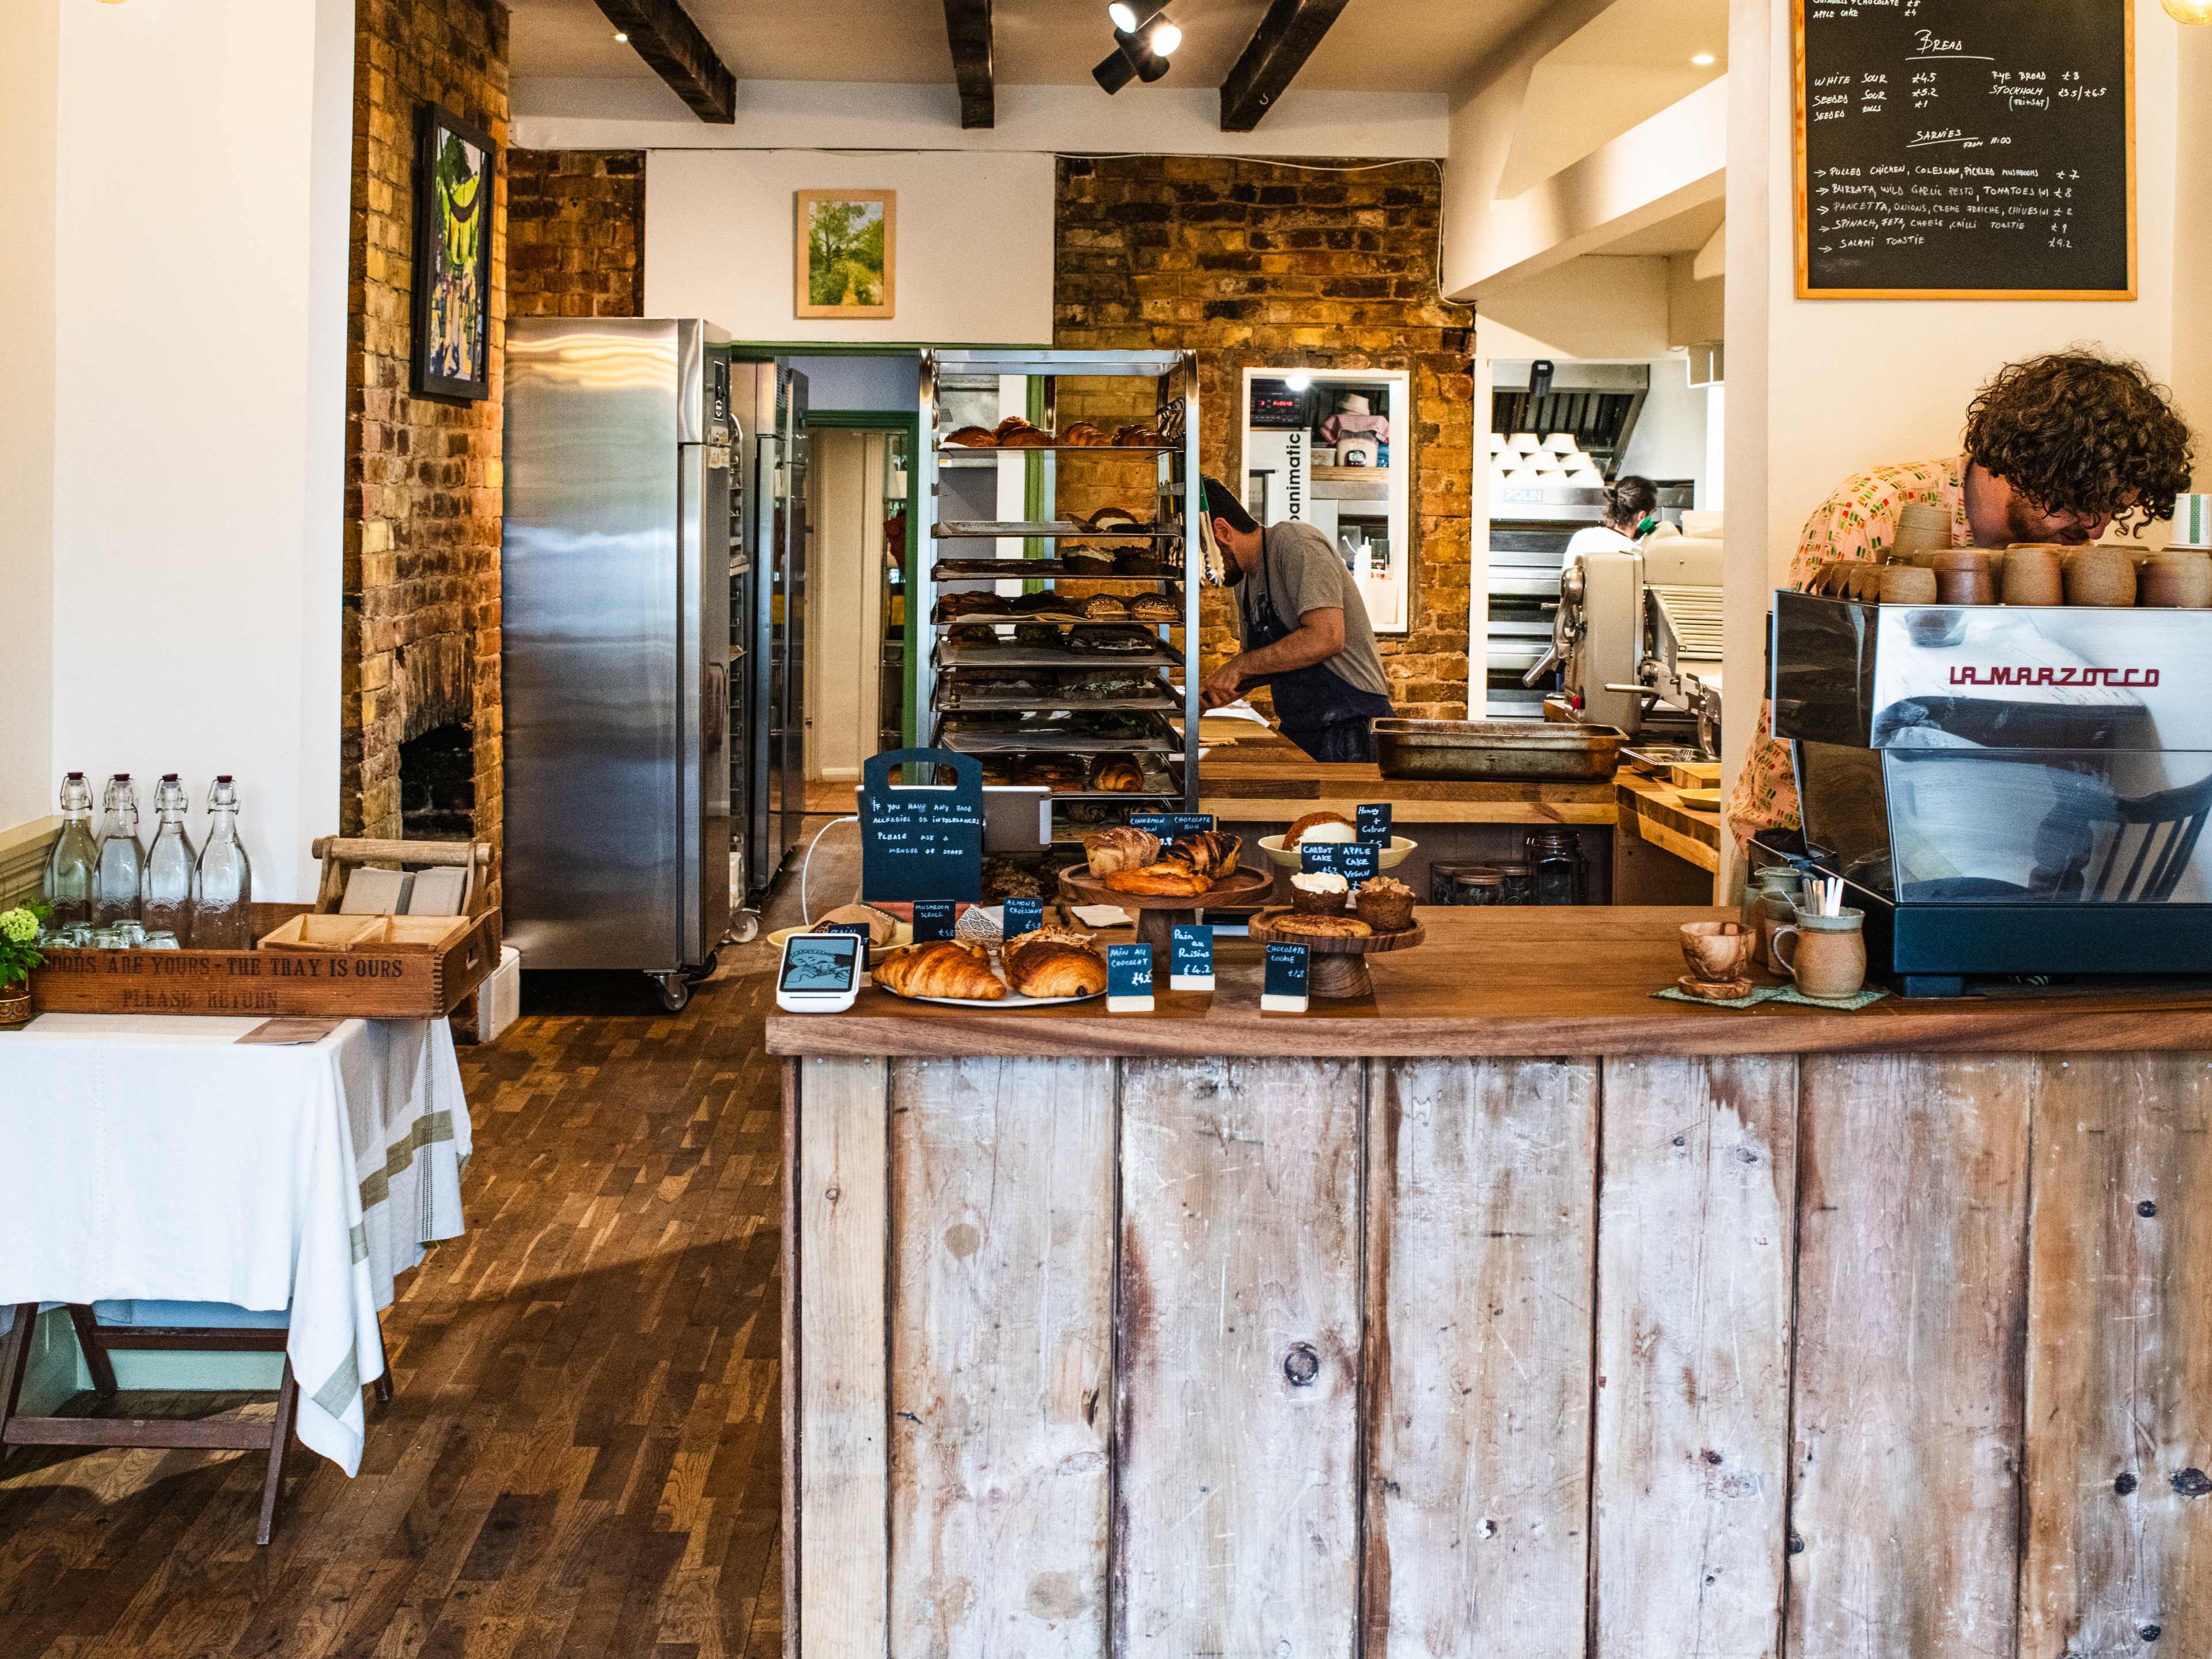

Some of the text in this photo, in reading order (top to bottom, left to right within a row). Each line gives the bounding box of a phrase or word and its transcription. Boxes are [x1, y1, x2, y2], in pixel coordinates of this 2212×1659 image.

[1813, 10, 1835, 18] APPLE
[1840, 7, 1858, 17] CAKE
[1861, 73, 1888, 83] SOUR
[1912, 72, 1937, 84] £4.5
[1991, 71, 2011, 84] RYE
[2018, 71, 2046, 81] BREAD
[1989, 85, 2043, 96] STOCKHOLM
[1812, 88, 1938, 107] SEEDED SOUR £5.2
[1814, 110, 1844, 121] SEEDED
[1862, 105, 1881, 113] ROLLS
[1911, 128, 1961, 143] SARNIES
[1830, 167, 1861, 176] PULLED
[2002, 169, 2039, 177] MUSHROOMS
[1911, 184, 1942, 196] GARLIC
[1983, 186, 2035, 195] TOMATOES
[1839, 237, 1874, 248] SALAMI
[1286, 433, 1300, 520] animatic
[1950, 666, 1976, 684] LA
[877, 832, 907, 840] PLEASE
[1346, 858, 1370, 866] CAKE
[1174, 929, 1194, 940] Pain
[1110, 948, 1128, 957] PAIN
[1267, 945, 1305, 954] CHOCOLATE
[105, 957, 143, 974] ARE
[150, 957, 209, 975] YOURS
[226, 957, 261, 976] THE
[271, 959, 321, 977] TRAY
[329, 959, 348, 977] IS
[355, 960, 403, 978] OURS
[1111, 958, 1148, 967] CHOCOLAT
[122, 989, 192, 1007] PLEASE
